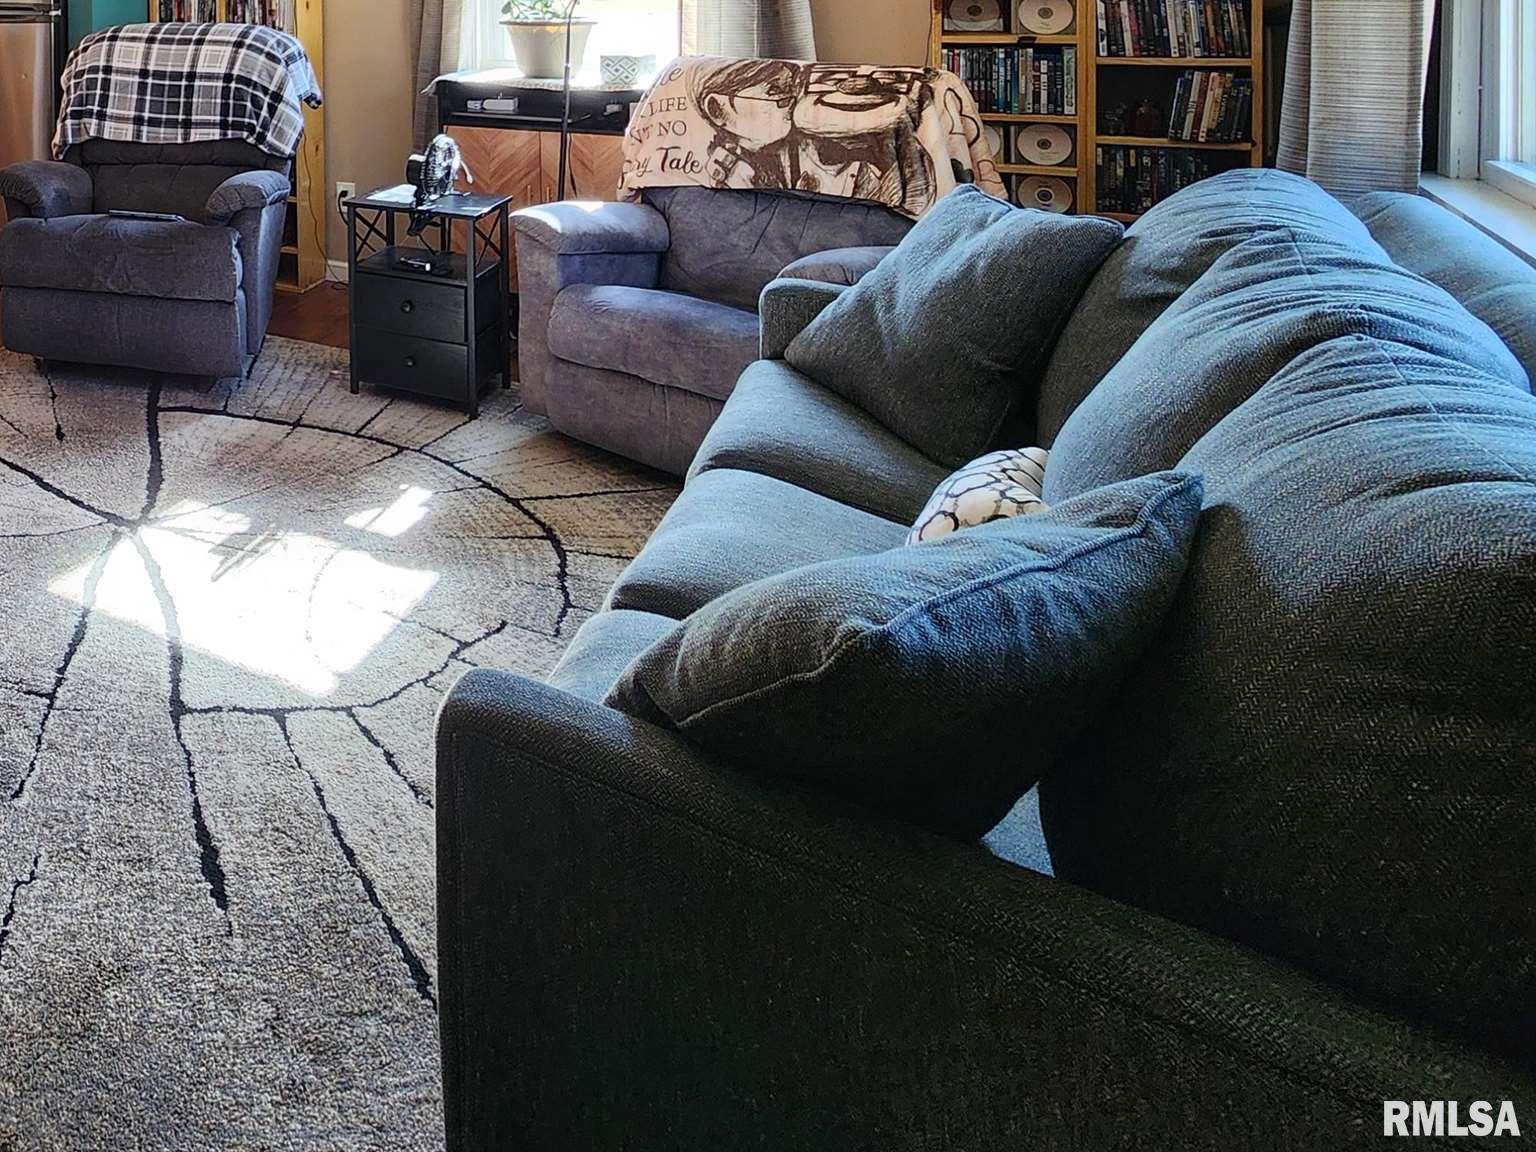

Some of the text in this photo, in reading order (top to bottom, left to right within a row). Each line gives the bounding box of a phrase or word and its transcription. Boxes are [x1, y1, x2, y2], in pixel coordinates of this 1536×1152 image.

[648, 96, 689, 117] LIFE
[656, 119, 687, 137] NO
[655, 145, 704, 175] Tale
